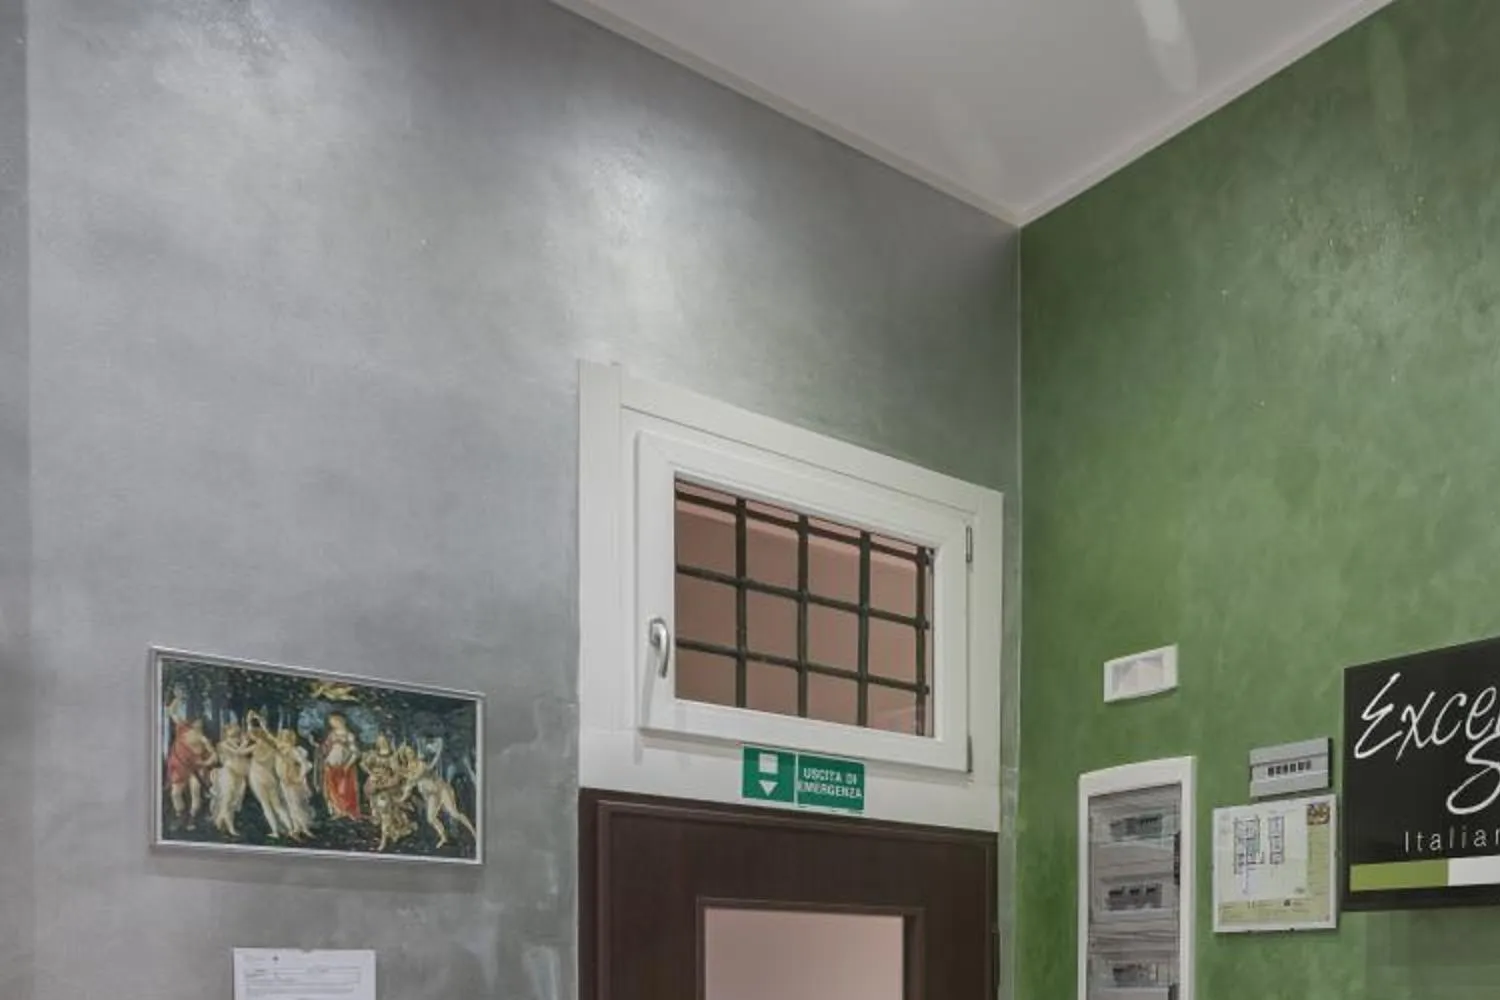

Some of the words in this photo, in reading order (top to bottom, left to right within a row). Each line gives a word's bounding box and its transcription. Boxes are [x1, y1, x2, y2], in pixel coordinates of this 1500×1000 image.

[803, 767, 842, 783] USCITA
[845, 772, 857, 785] DI
[798, 780, 862, 799] EMERGENZA
